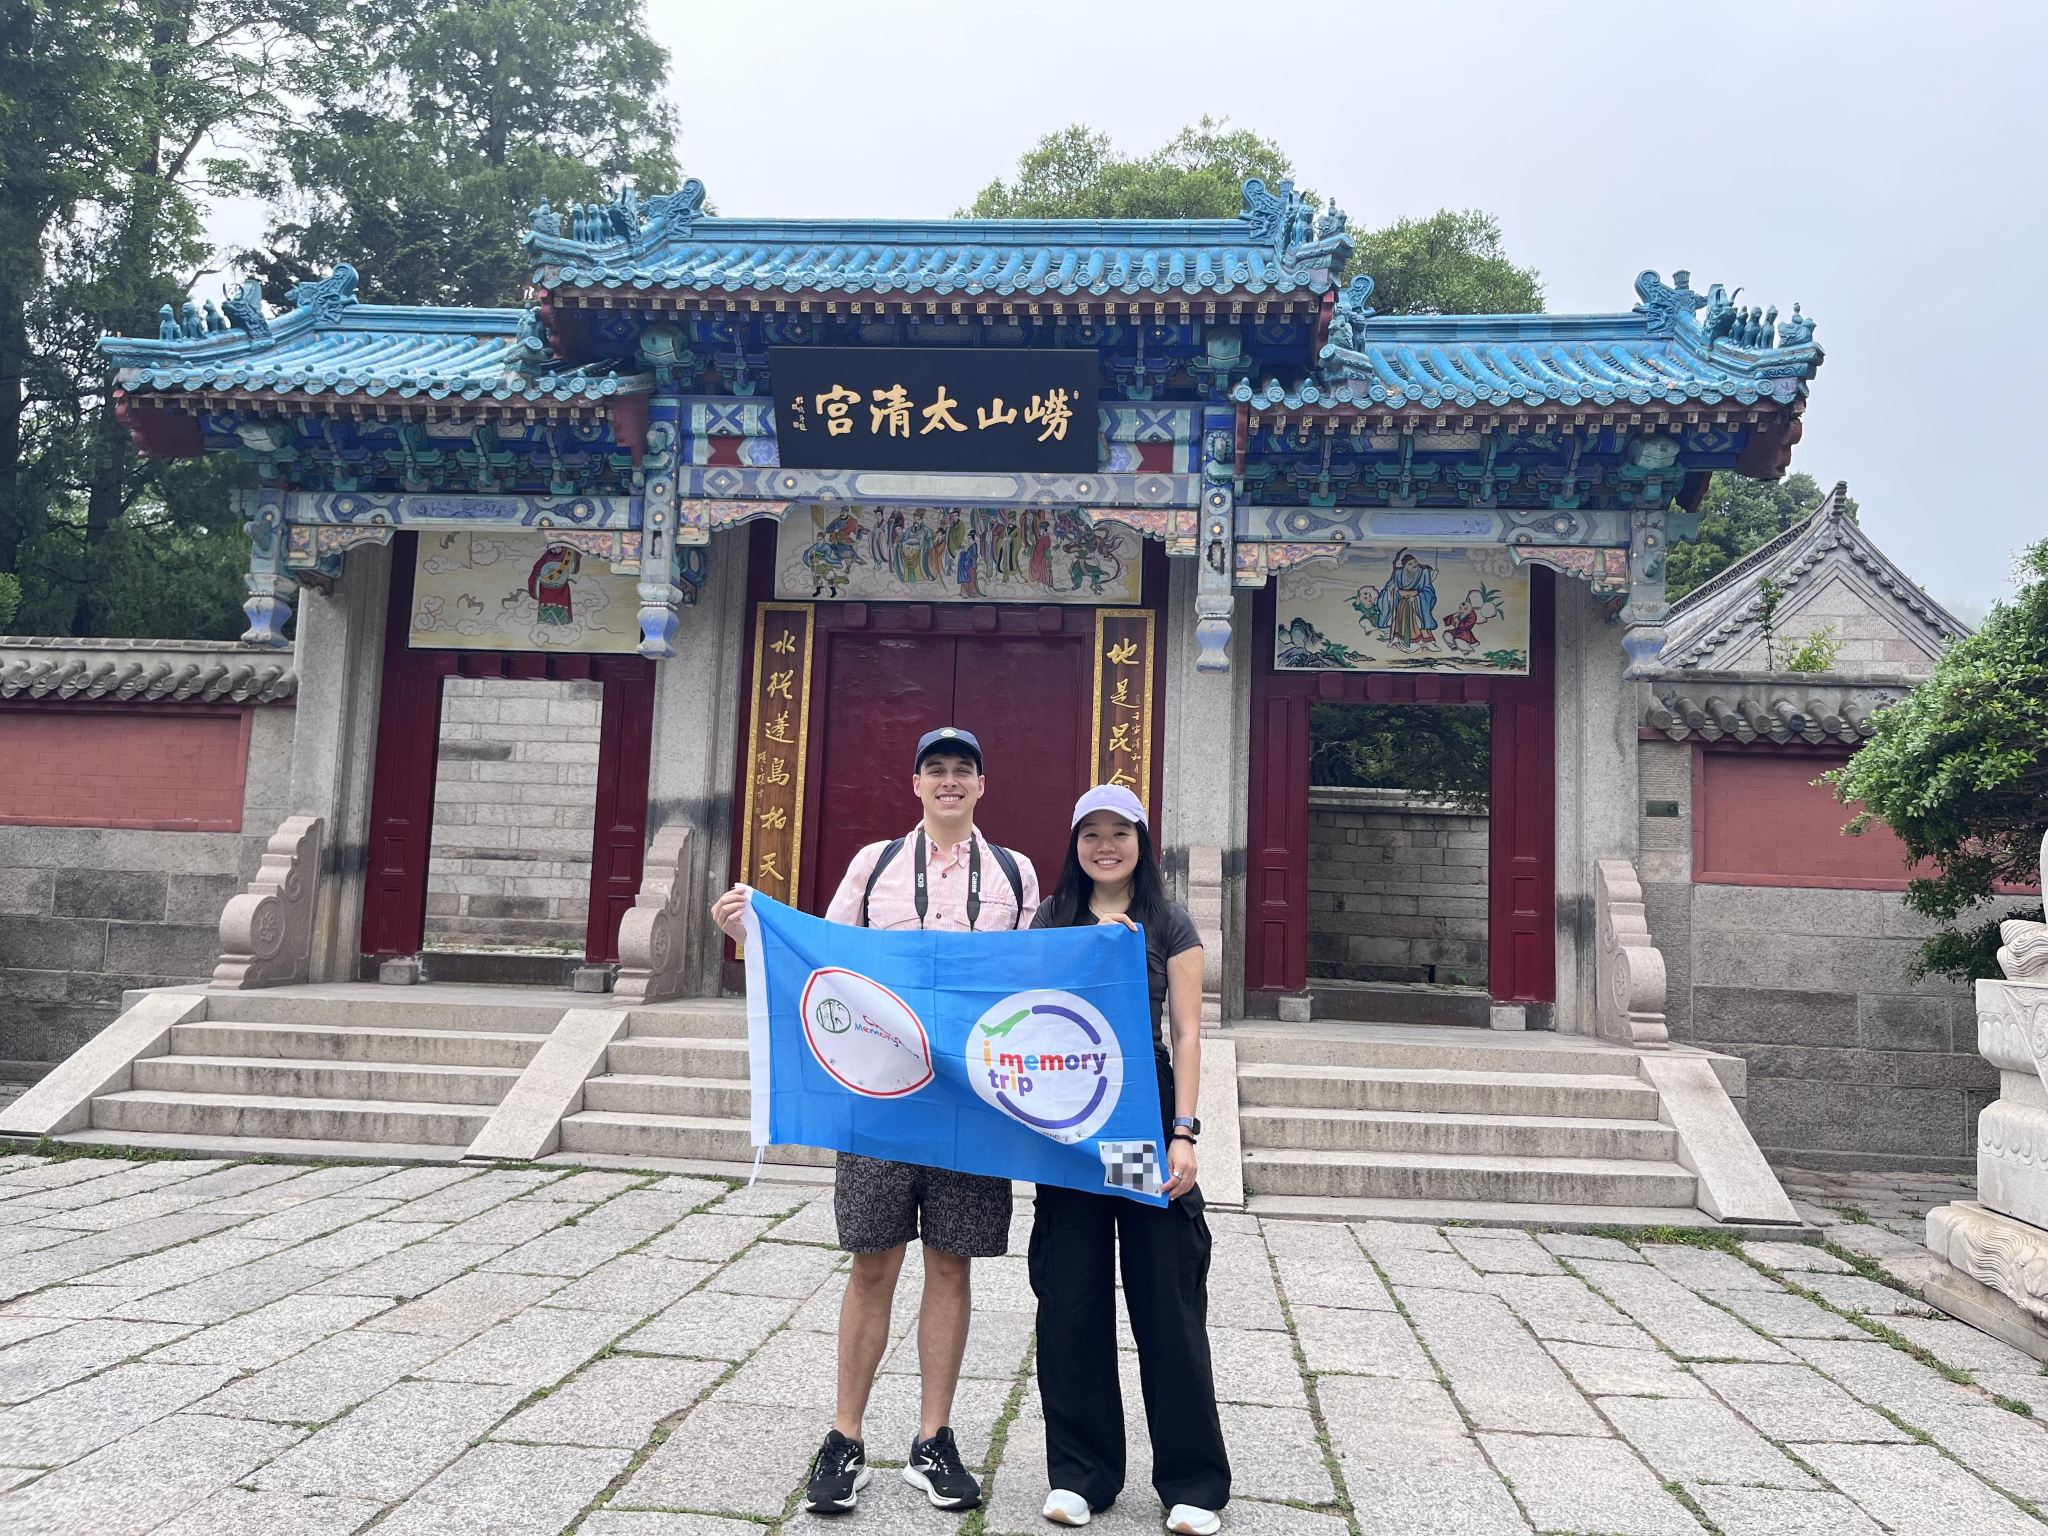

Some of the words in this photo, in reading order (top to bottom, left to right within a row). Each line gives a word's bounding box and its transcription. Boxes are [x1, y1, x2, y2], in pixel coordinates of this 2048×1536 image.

[917, 872, 925, 888] EOS
[971, 871, 979, 893] Canon
[999, 1052, 1107, 1075] memory
[987, 1069, 1034, 1096] trip
